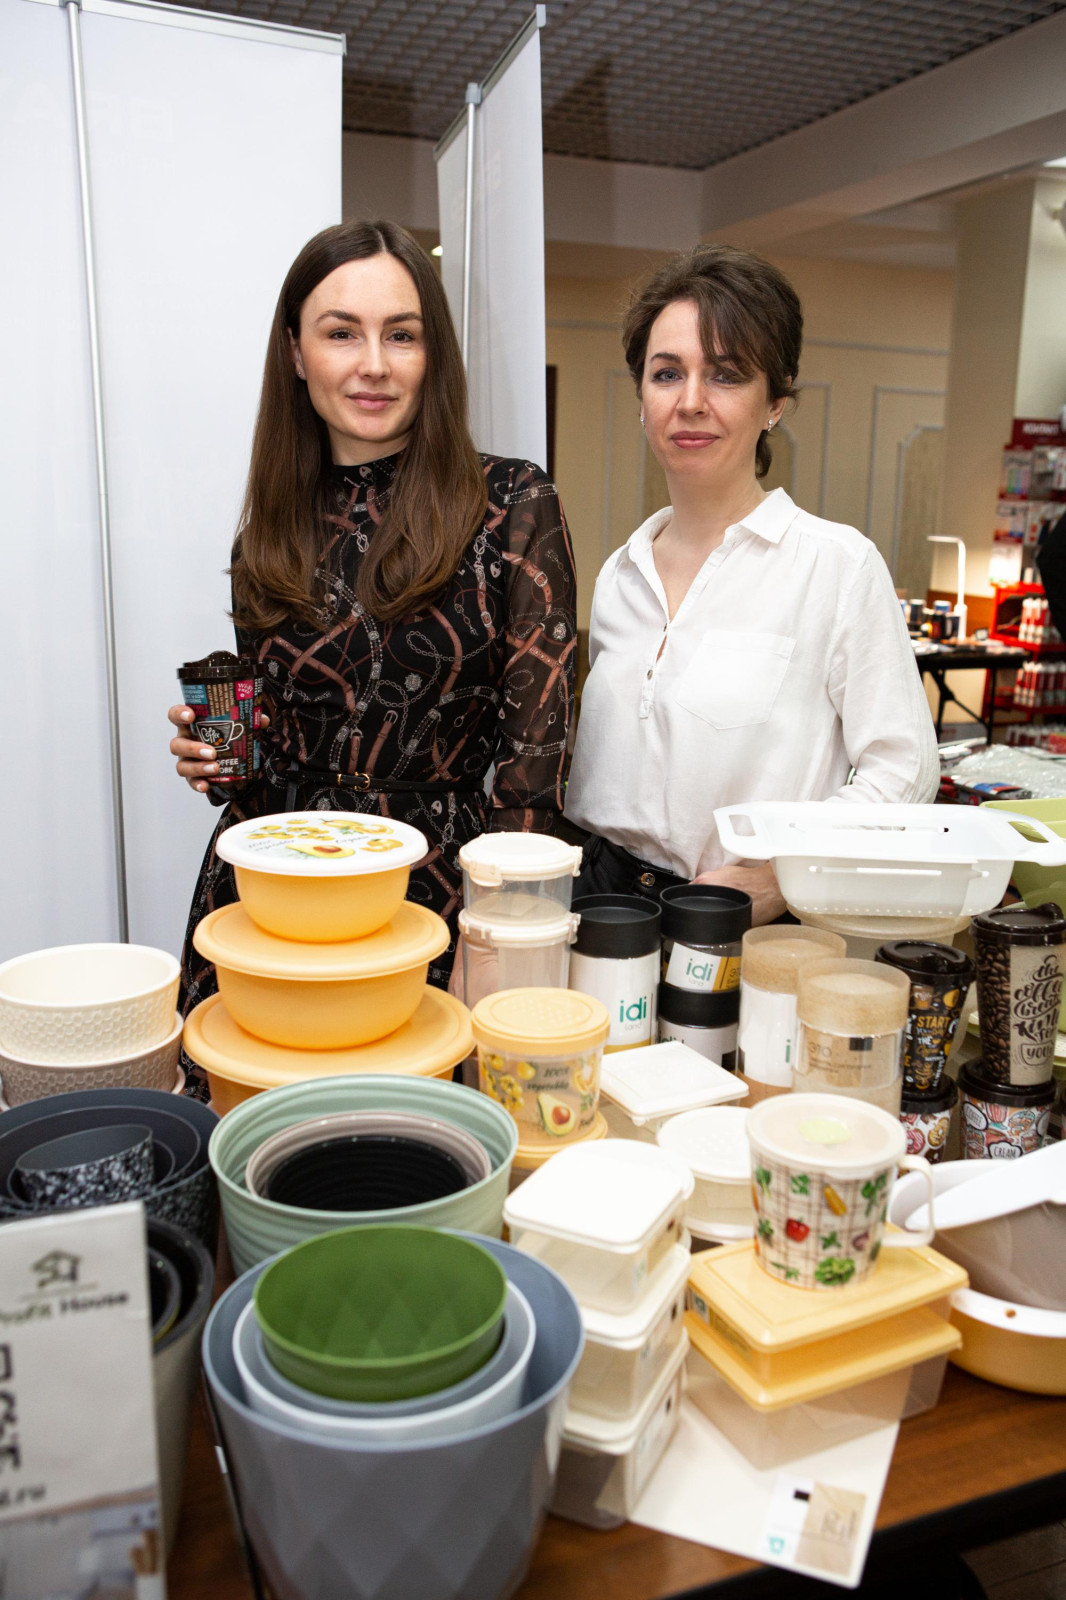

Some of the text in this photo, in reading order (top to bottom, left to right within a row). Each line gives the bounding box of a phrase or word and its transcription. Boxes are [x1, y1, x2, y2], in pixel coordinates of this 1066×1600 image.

[201, 727, 220, 743] Coffee
[216, 758, 239, 767] OFFEE
[686, 958, 714, 982] idi
[620, 996, 647, 1023] idi
[917, 1016, 951, 1029] START
[966, 1104, 983, 1127] COFFEE
[994, 1148, 1017, 1159] CREAM
